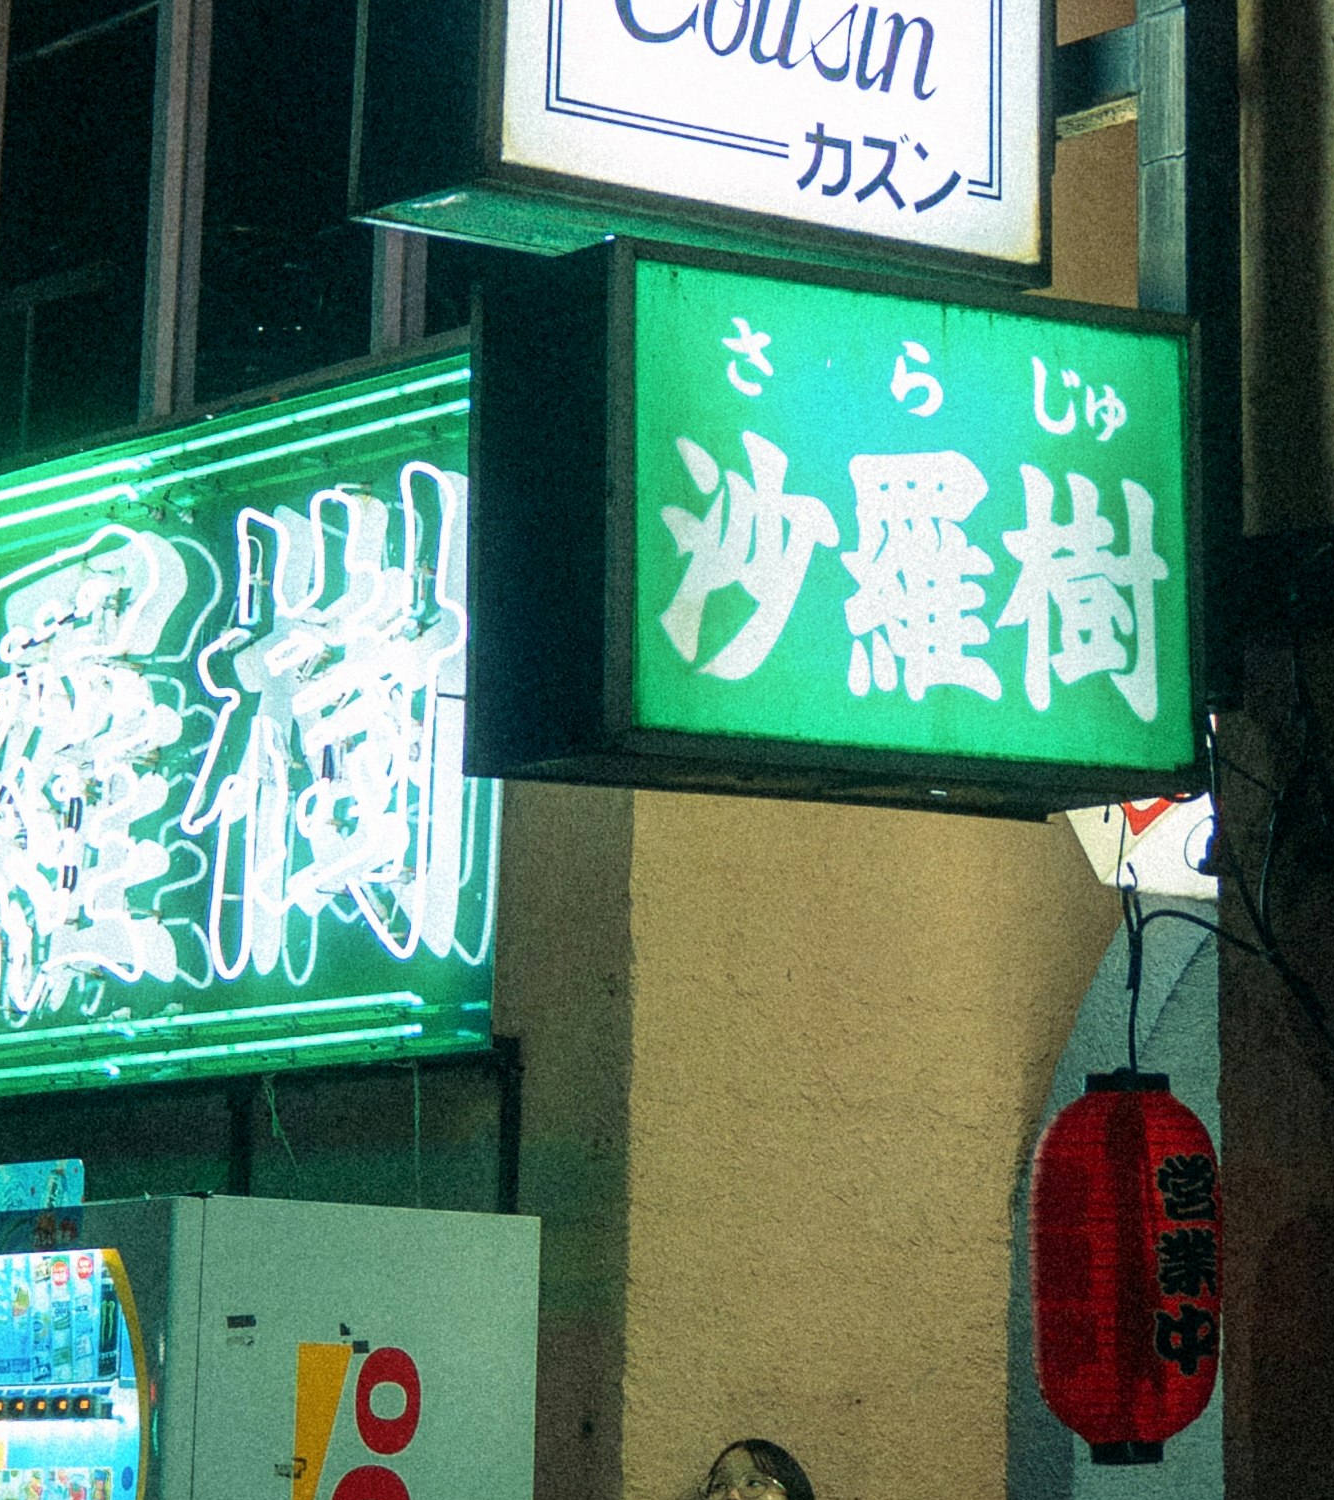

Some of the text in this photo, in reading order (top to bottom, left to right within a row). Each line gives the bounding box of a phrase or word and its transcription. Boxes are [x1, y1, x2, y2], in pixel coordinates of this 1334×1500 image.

[797, 122, 962, 214] カズン
[660, 431, 1170, 724] 沙羅樹
[1155, 1154, 1217, 1376] 営業中
